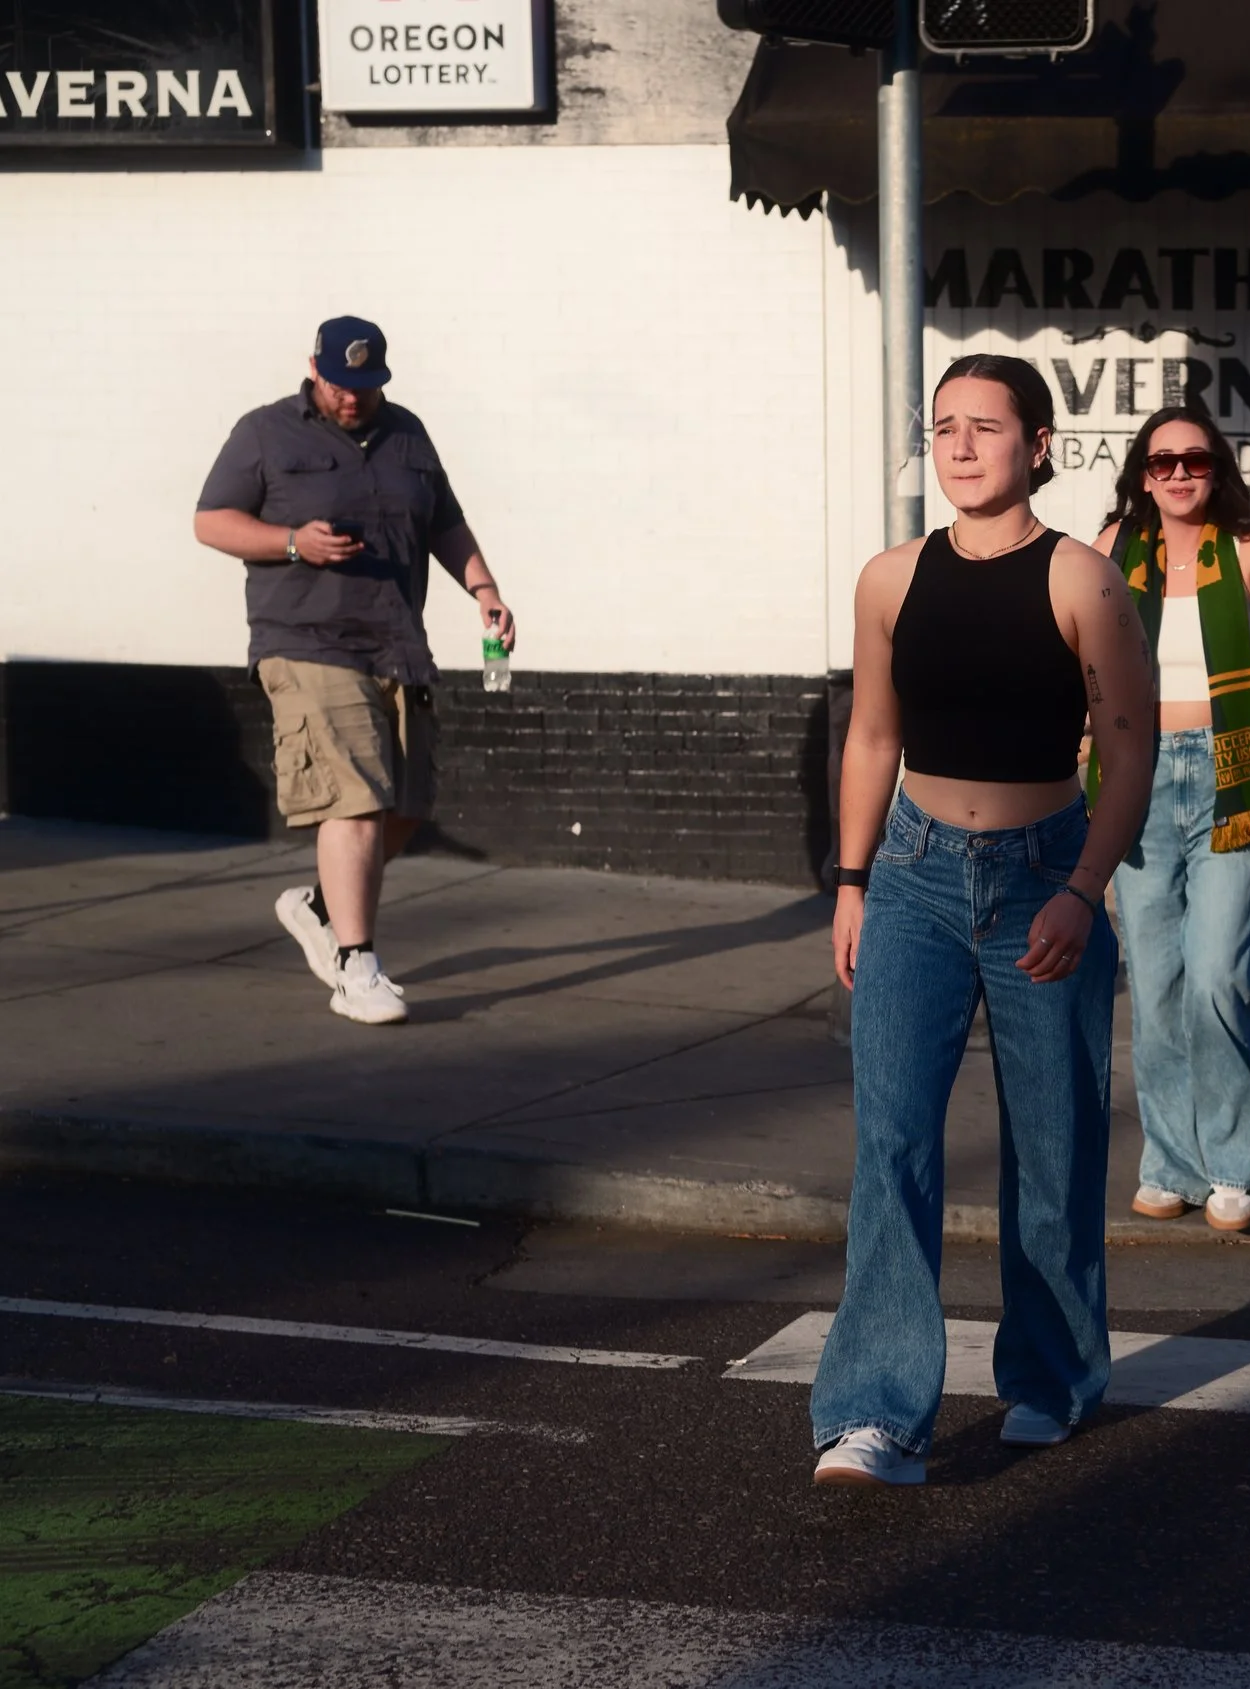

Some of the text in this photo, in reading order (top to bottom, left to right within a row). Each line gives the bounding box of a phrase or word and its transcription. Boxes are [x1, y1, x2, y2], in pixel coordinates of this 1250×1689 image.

[350, 24, 504, 52] OREGON
[369, 63, 488, 85] LOTTERY
[0, 69, 253, 118] VERNA
[1063, 437, 1137, 471] BA
